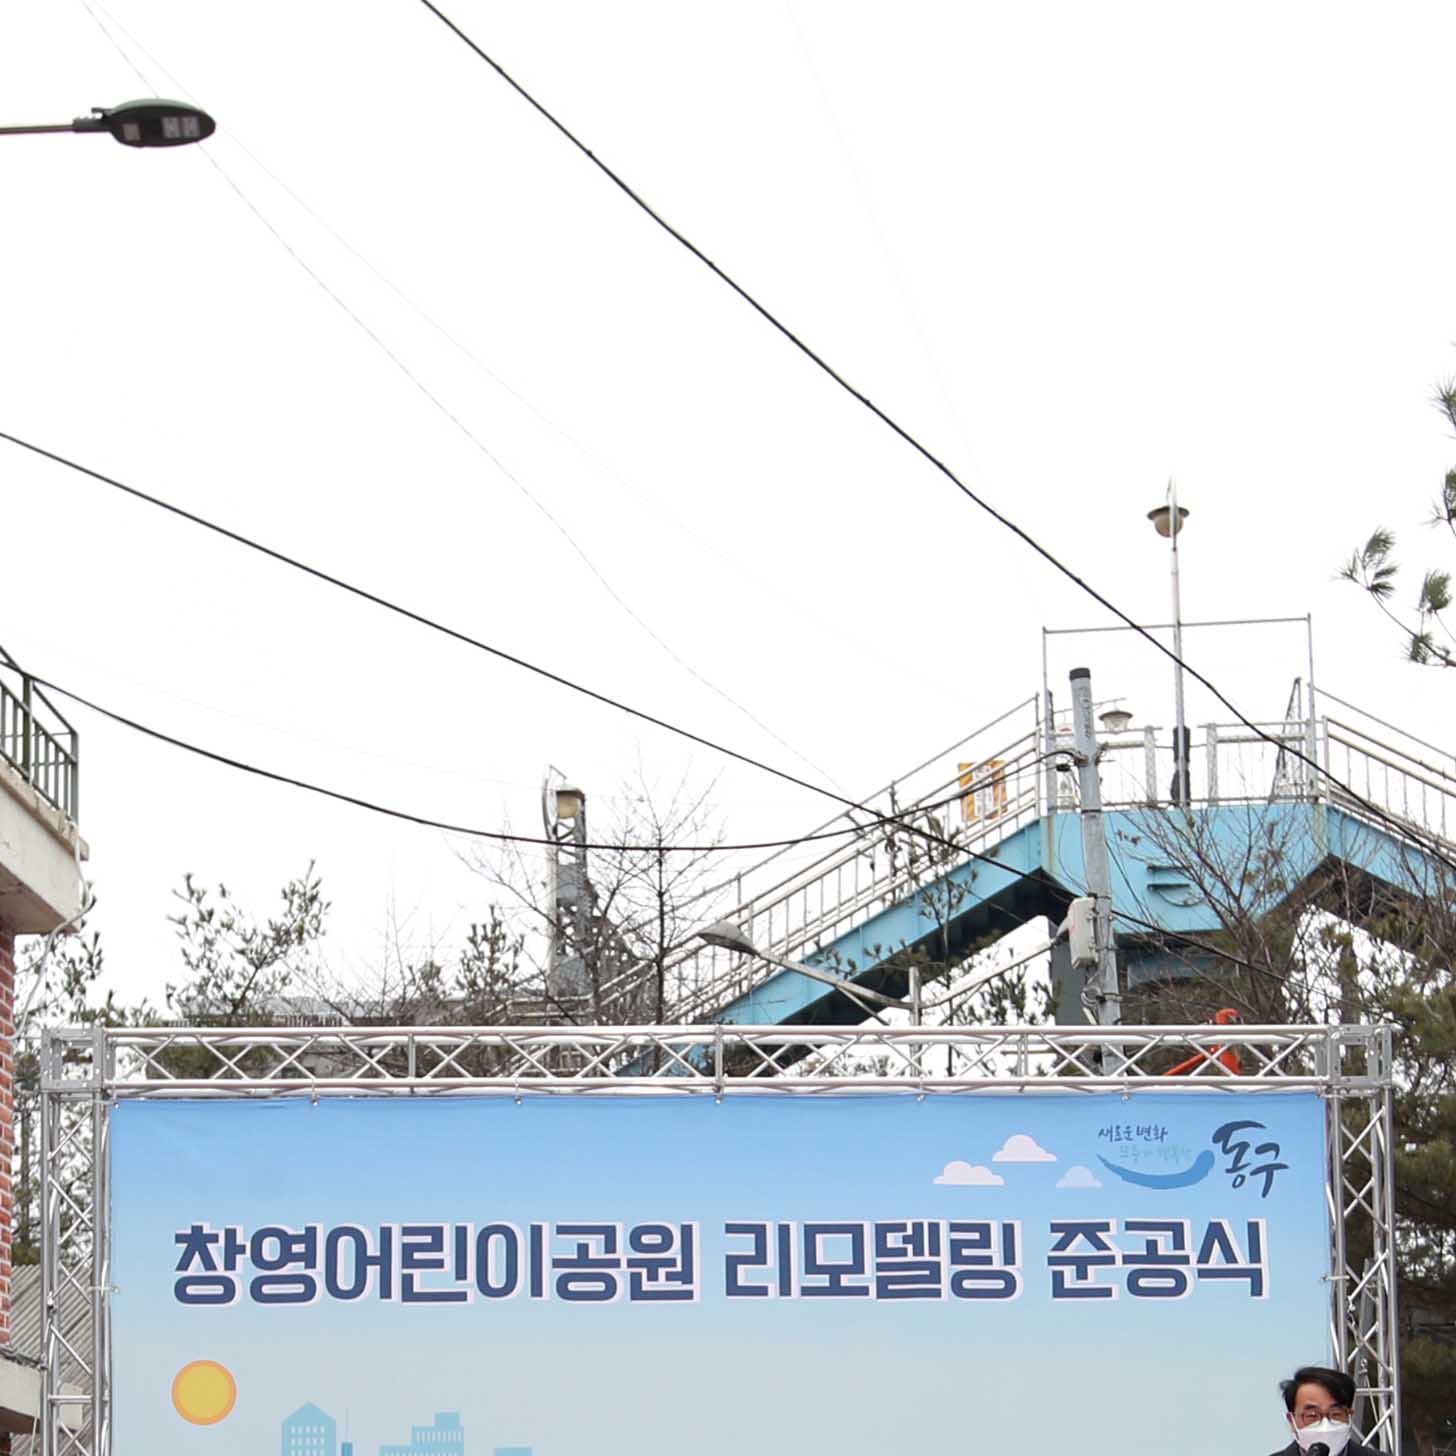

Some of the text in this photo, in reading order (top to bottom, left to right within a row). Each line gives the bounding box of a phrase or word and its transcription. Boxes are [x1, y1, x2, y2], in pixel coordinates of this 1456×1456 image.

[1097, 1124, 1169, 1143] 새로운 변화
[1212, 1120, 1290, 1199] 동구
[173, 1218, 1265, 1305] 창영어린이공원 리모델링 준공식
